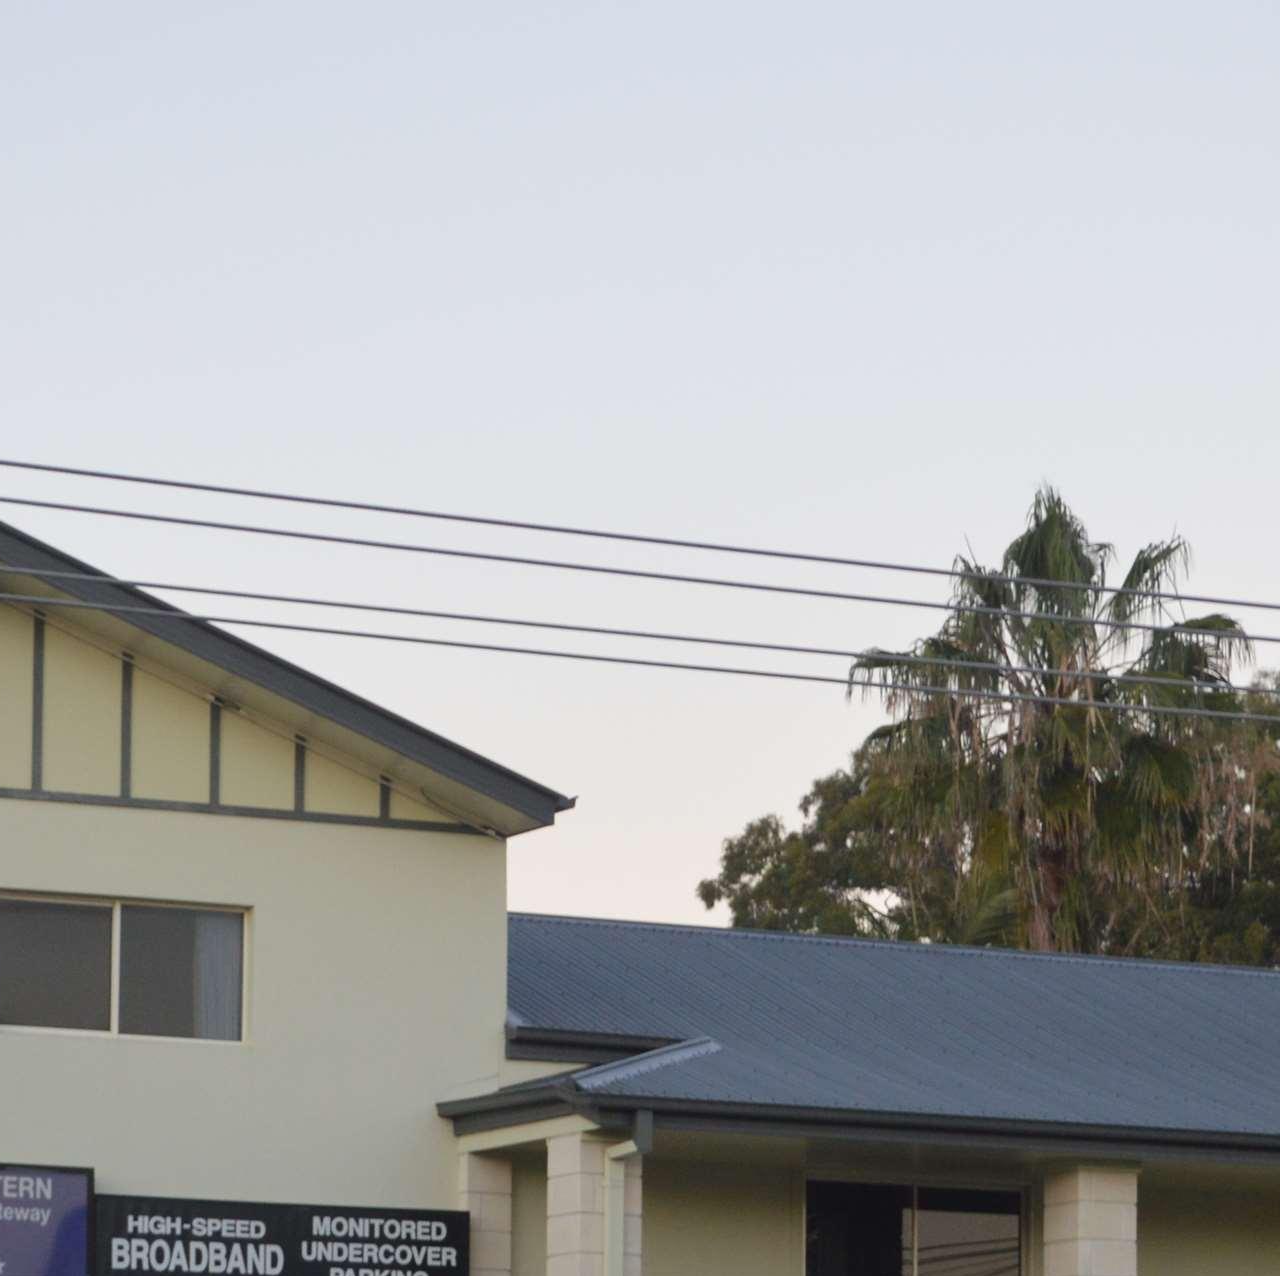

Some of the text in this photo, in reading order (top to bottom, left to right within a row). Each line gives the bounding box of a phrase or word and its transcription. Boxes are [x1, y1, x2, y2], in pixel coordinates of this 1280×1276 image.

[126, 1214, 267, 1239] HIGH-SPEED
[311, 1215, 448, 1241] MONITORED
[111, 1237, 285, 1276] BROADBAND
[301, 1241, 458, 1268] UNDERCOVER
